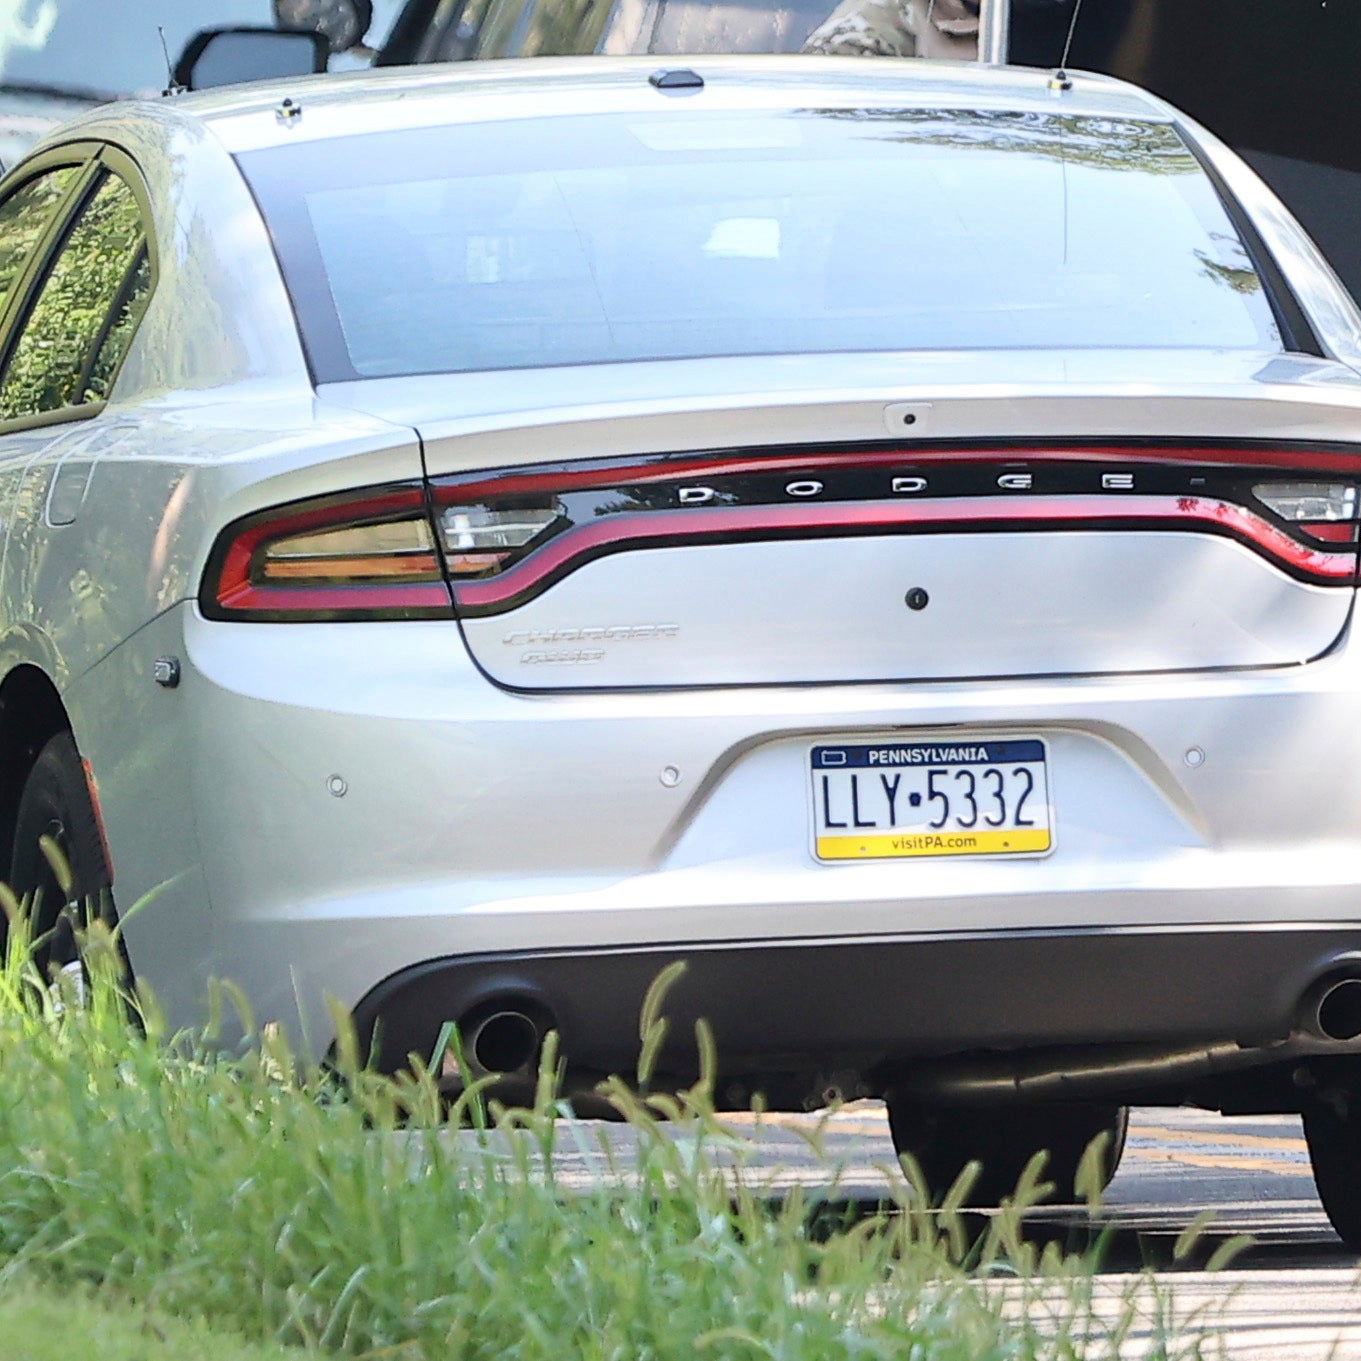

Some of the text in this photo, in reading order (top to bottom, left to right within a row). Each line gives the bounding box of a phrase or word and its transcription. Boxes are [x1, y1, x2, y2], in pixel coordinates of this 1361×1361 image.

[679, 472, 1135, 504] DODGE
[868, 747, 989, 764] PENNSYLVANIA
[892, 836, 977, 849] visitPA.com
